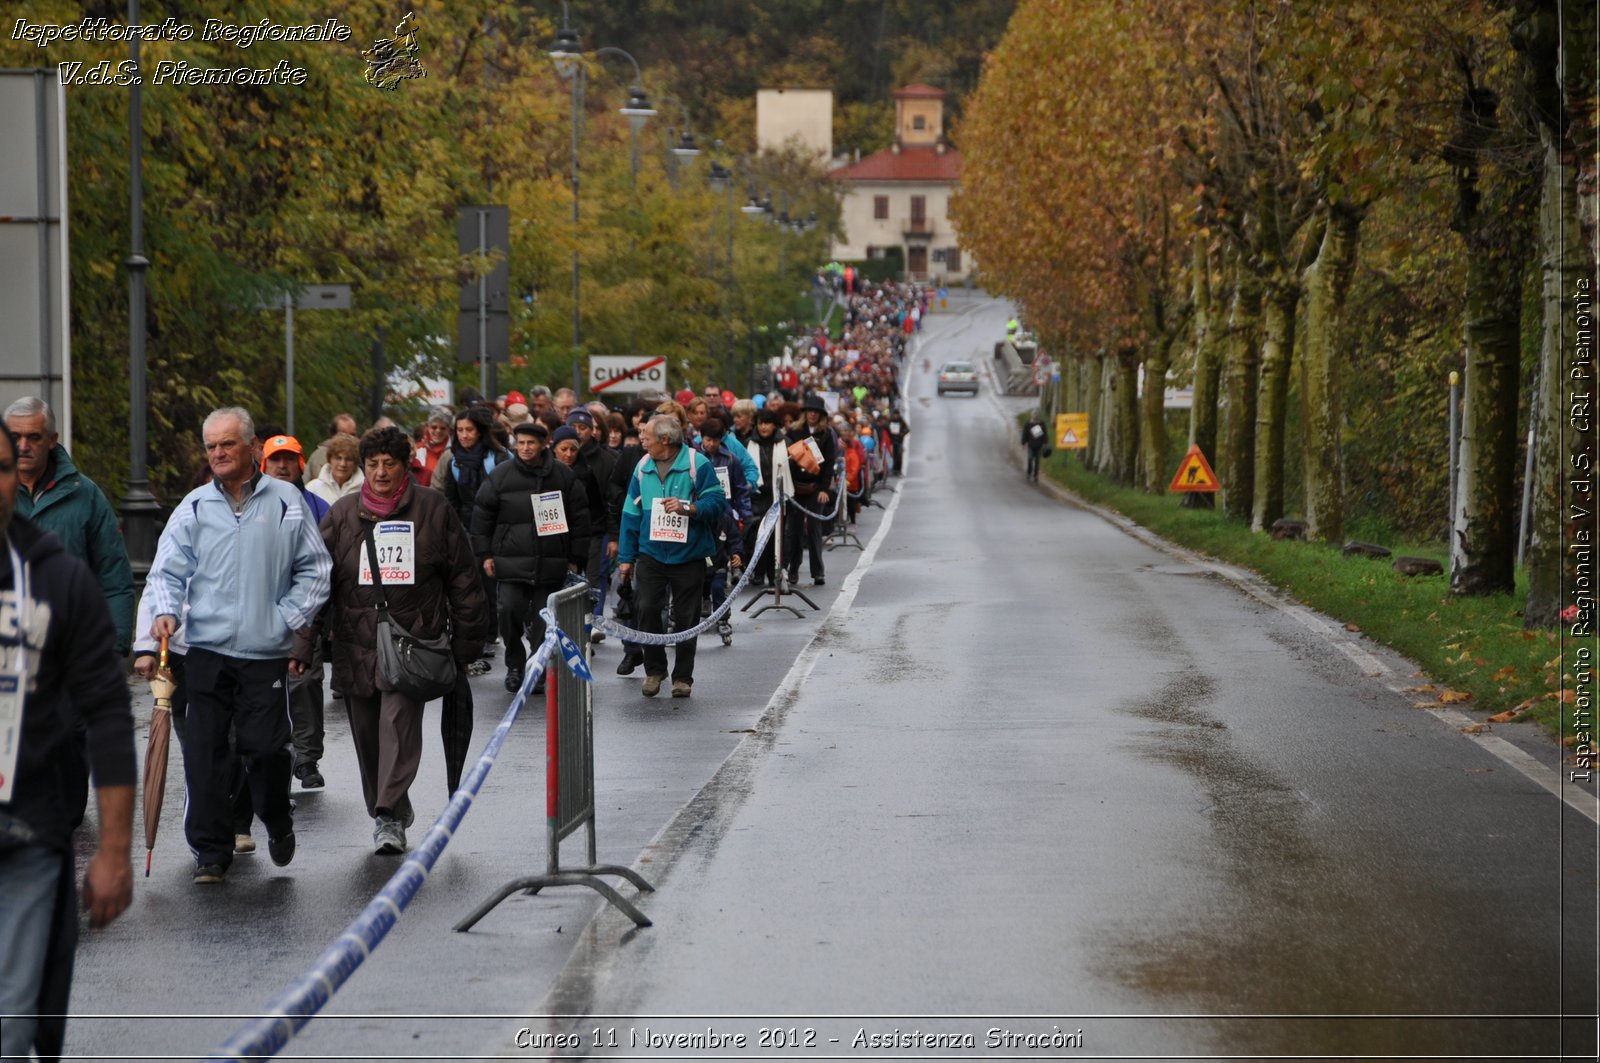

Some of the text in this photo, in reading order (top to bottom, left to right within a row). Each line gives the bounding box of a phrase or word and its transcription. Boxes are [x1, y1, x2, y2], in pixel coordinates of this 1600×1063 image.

[595, 367, 661, 382] CUNEO
[539, 508, 559, 522] 11966
[658, 515, 682, 528] 11965
[364, 567, 411, 581] iprcoop
